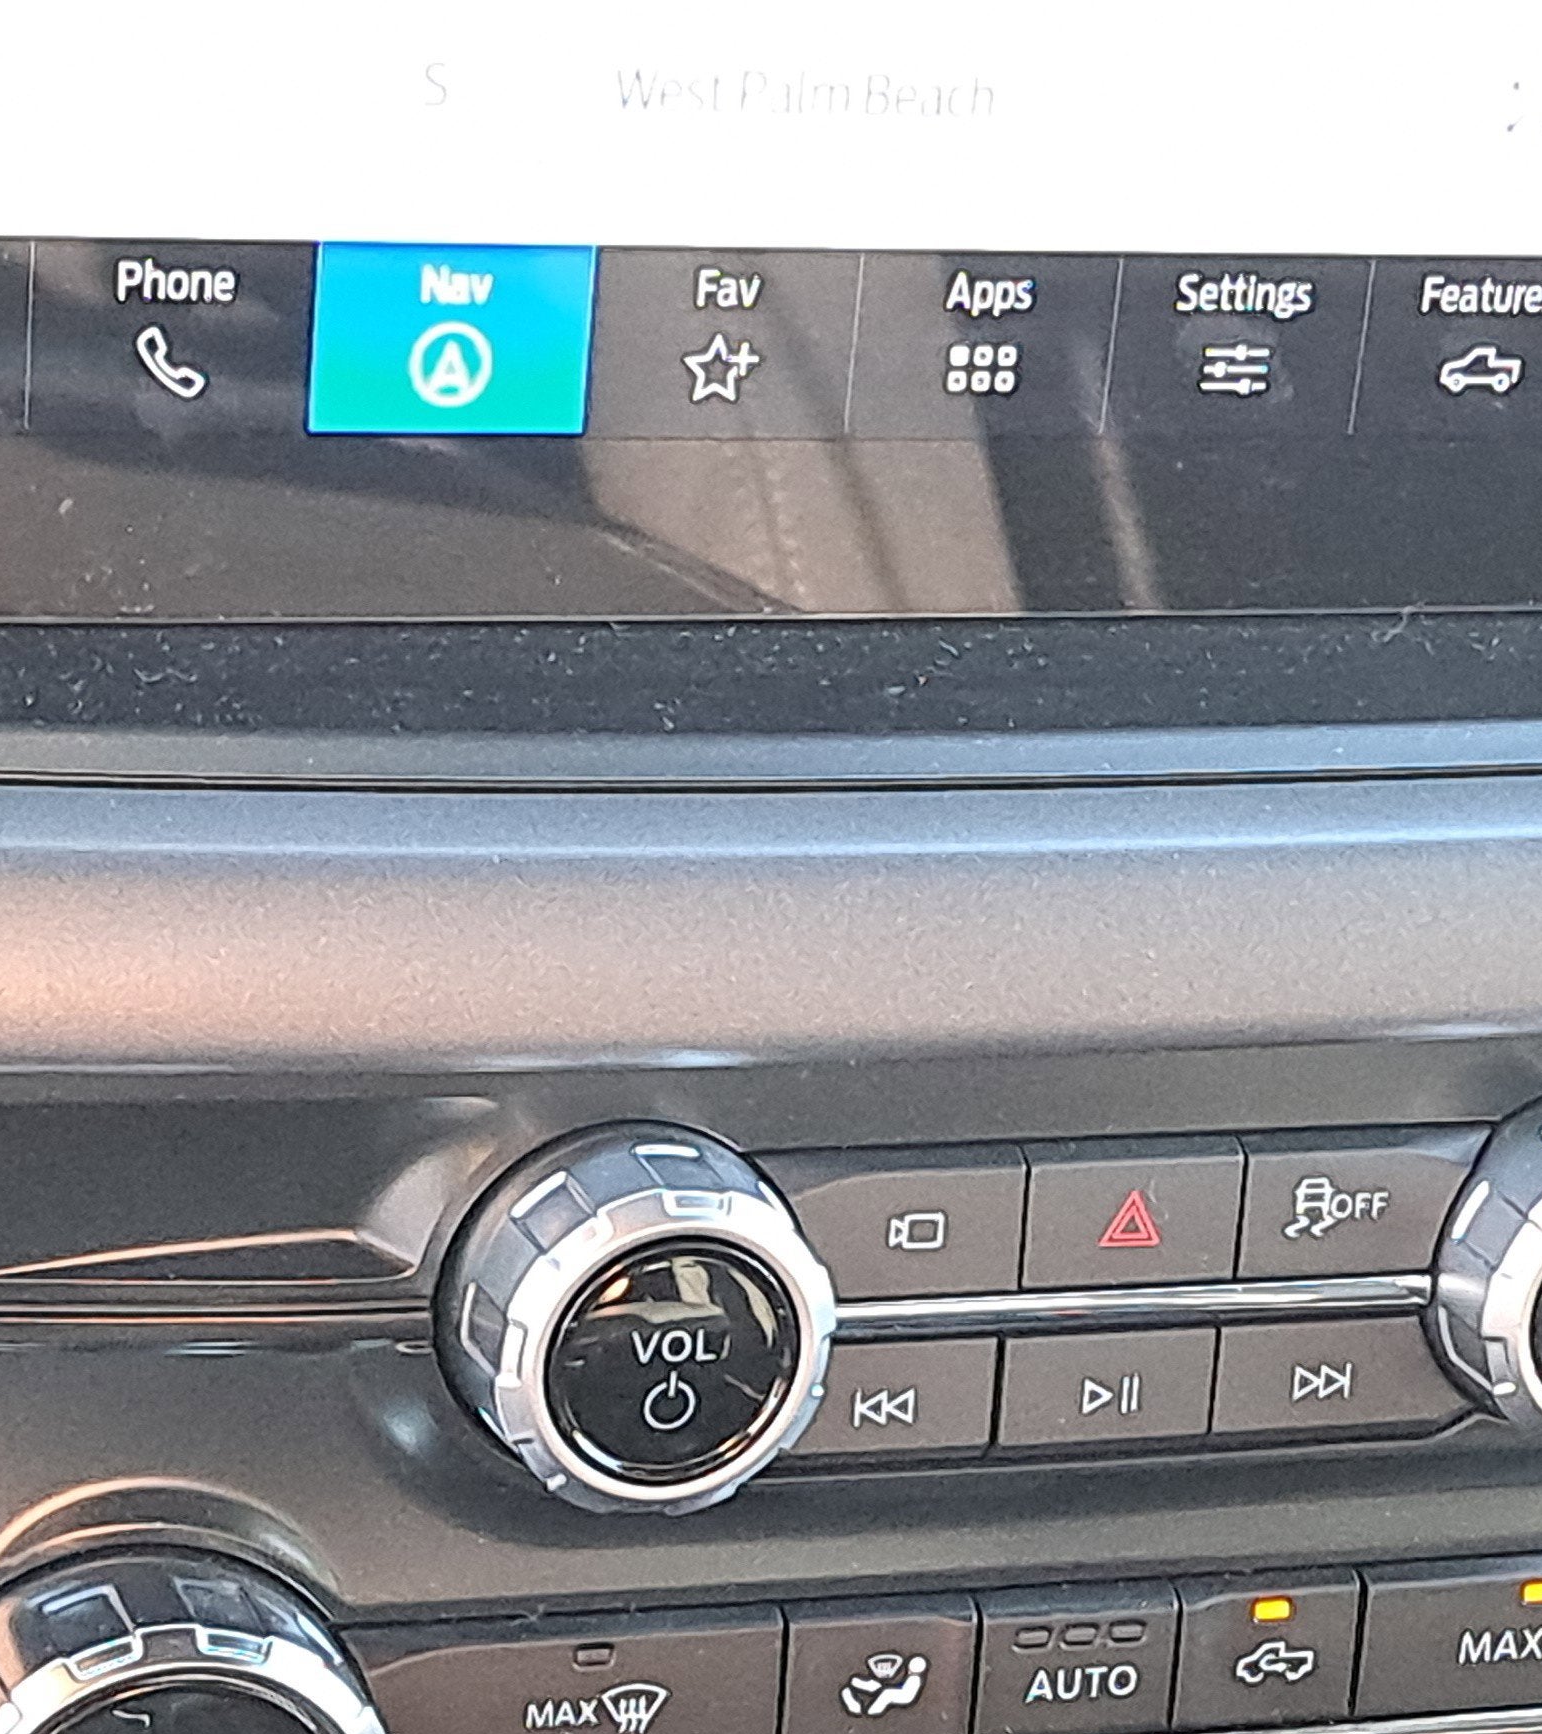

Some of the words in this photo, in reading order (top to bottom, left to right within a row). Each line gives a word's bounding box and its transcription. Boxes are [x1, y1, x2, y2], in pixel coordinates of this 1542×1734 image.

[616, 68, 721, 112] West
[740, 70, 850, 115] Palm
[864, 75, 995, 117] Beach
[117, 259, 236, 304] Phone
[421, 266, 493, 304] Nav
[695, 269, 761, 309] Fav
[947, 272, 1032, 318] Apps
[1176, 274, 1312, 319] Settings
[1330, 1191, 1389, 1222] OFF
[631, 1329, 717, 1365] VOL
[1026, 1665, 1139, 1703] AUTO
[525, 1698, 598, 1730] MAX
